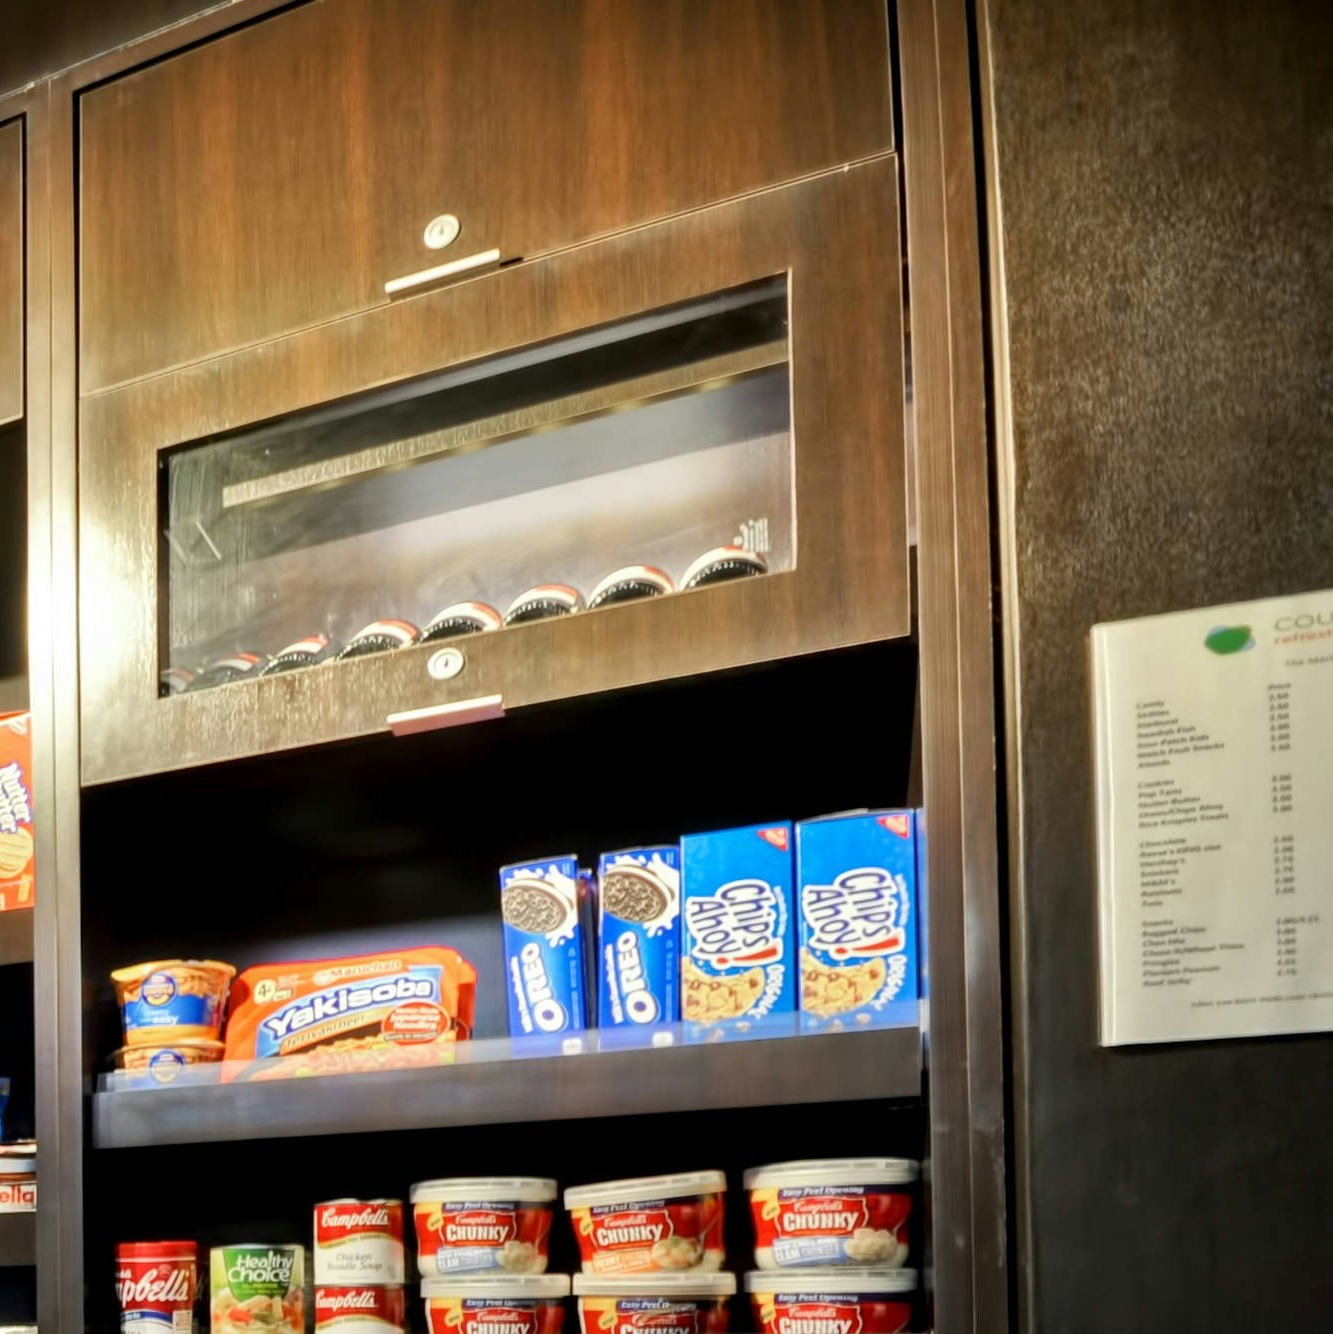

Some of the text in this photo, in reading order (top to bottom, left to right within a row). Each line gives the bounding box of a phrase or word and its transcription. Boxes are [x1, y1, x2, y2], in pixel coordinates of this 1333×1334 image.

[1275, 612, 1333, 632] COU
[719, 882, 771, 950] Chips
[838, 871, 892, 940] Chips
[330, 959, 402, 979] Maruchan
[618, 931, 660, 1024] OREO
[520, 943, 568, 1033] OREO
[266, 978, 434, 1040] Yakisoba
[321, 1206, 390, 1229] Campbell's
[782, 1211, 860, 1232] CHUNKY
[445, 1225, 509, 1243] CHUNKY
[596, 1223, 664, 1246] CHUNKY
[237, 1250, 293, 1275] Healthy
[335, 1252, 373, 1262] Chicken
[227, 1265, 291, 1283] Choice
[315, 1291, 376, 1309] Campbell's
